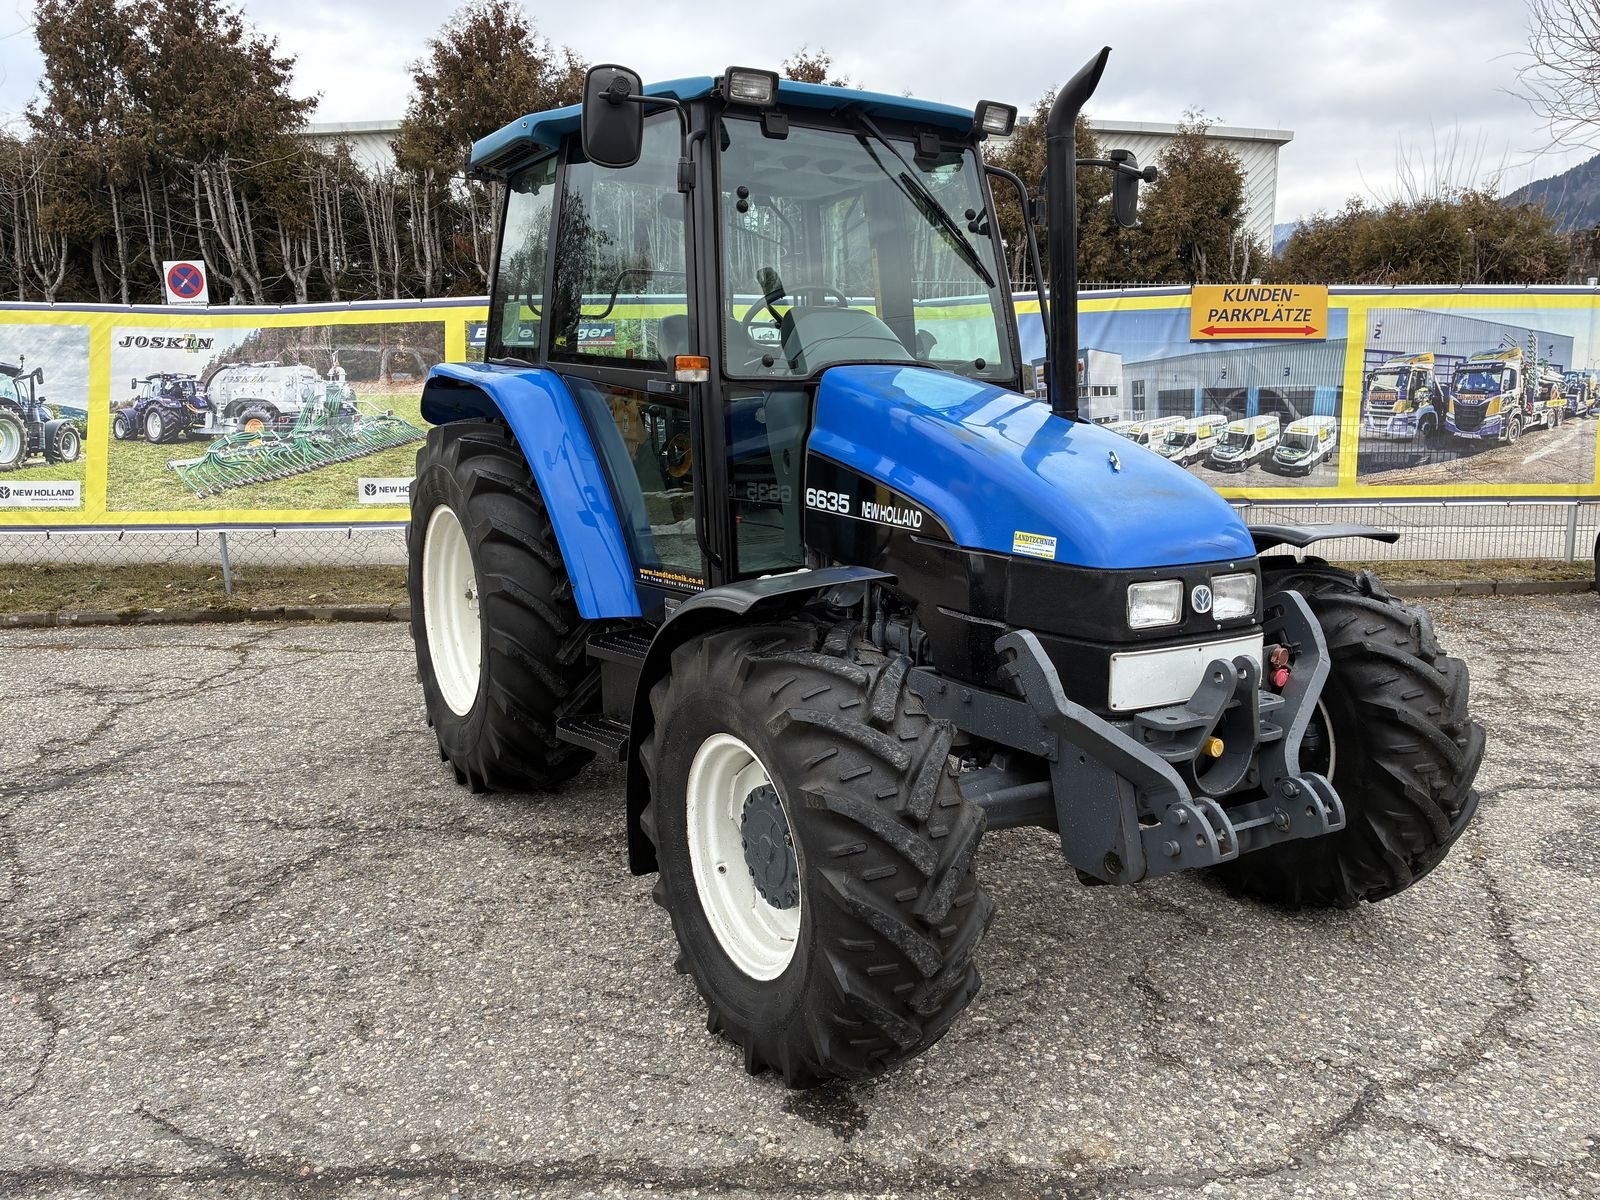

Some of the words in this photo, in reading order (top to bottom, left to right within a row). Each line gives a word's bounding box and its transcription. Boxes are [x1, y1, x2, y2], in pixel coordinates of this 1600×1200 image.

[1223, 288, 1300, 302] KUNDEN-
[1207, 304, 1312, 322] PARKPLÄTZE
[1374, 328, 1381, 339] 2
[118, 335, 214, 350] JOSKIN
[1441, 336, 1447, 345] 3
[1283, 367, 1291, 377] 3
[12, 489, 33, 497] NEW
[34, 489, 75, 497] HOLLAND
[806, 487, 850, 513] 6635
[1015, 533, 1055, 546] LANDTECHNIK
[639, 568, 704, 585] www.landtechnik.co.at
